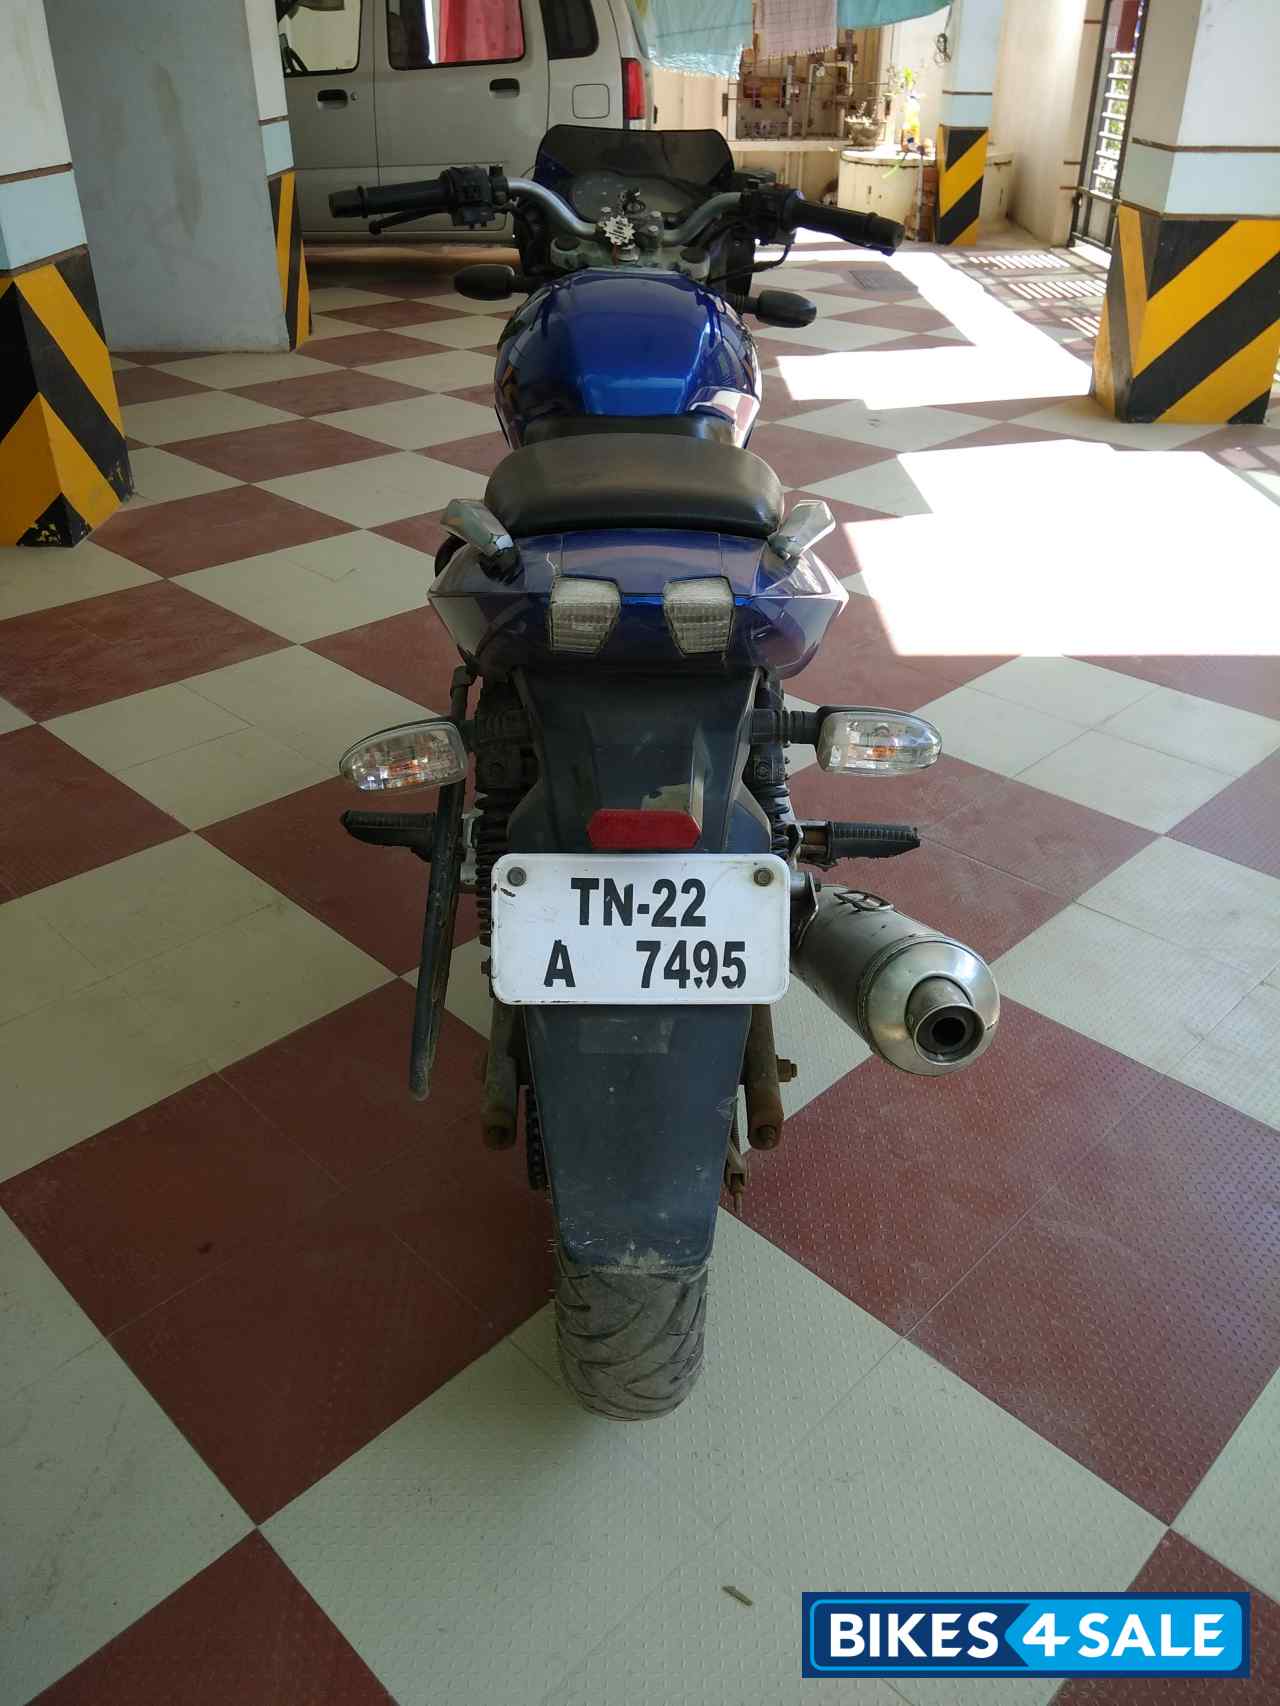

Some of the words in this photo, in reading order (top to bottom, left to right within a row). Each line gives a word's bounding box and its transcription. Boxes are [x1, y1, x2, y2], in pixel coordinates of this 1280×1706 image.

[570, 877, 706, 928] TN-22
[543, 939, 576, 988] A
[636, 940, 747, 989] 7495
